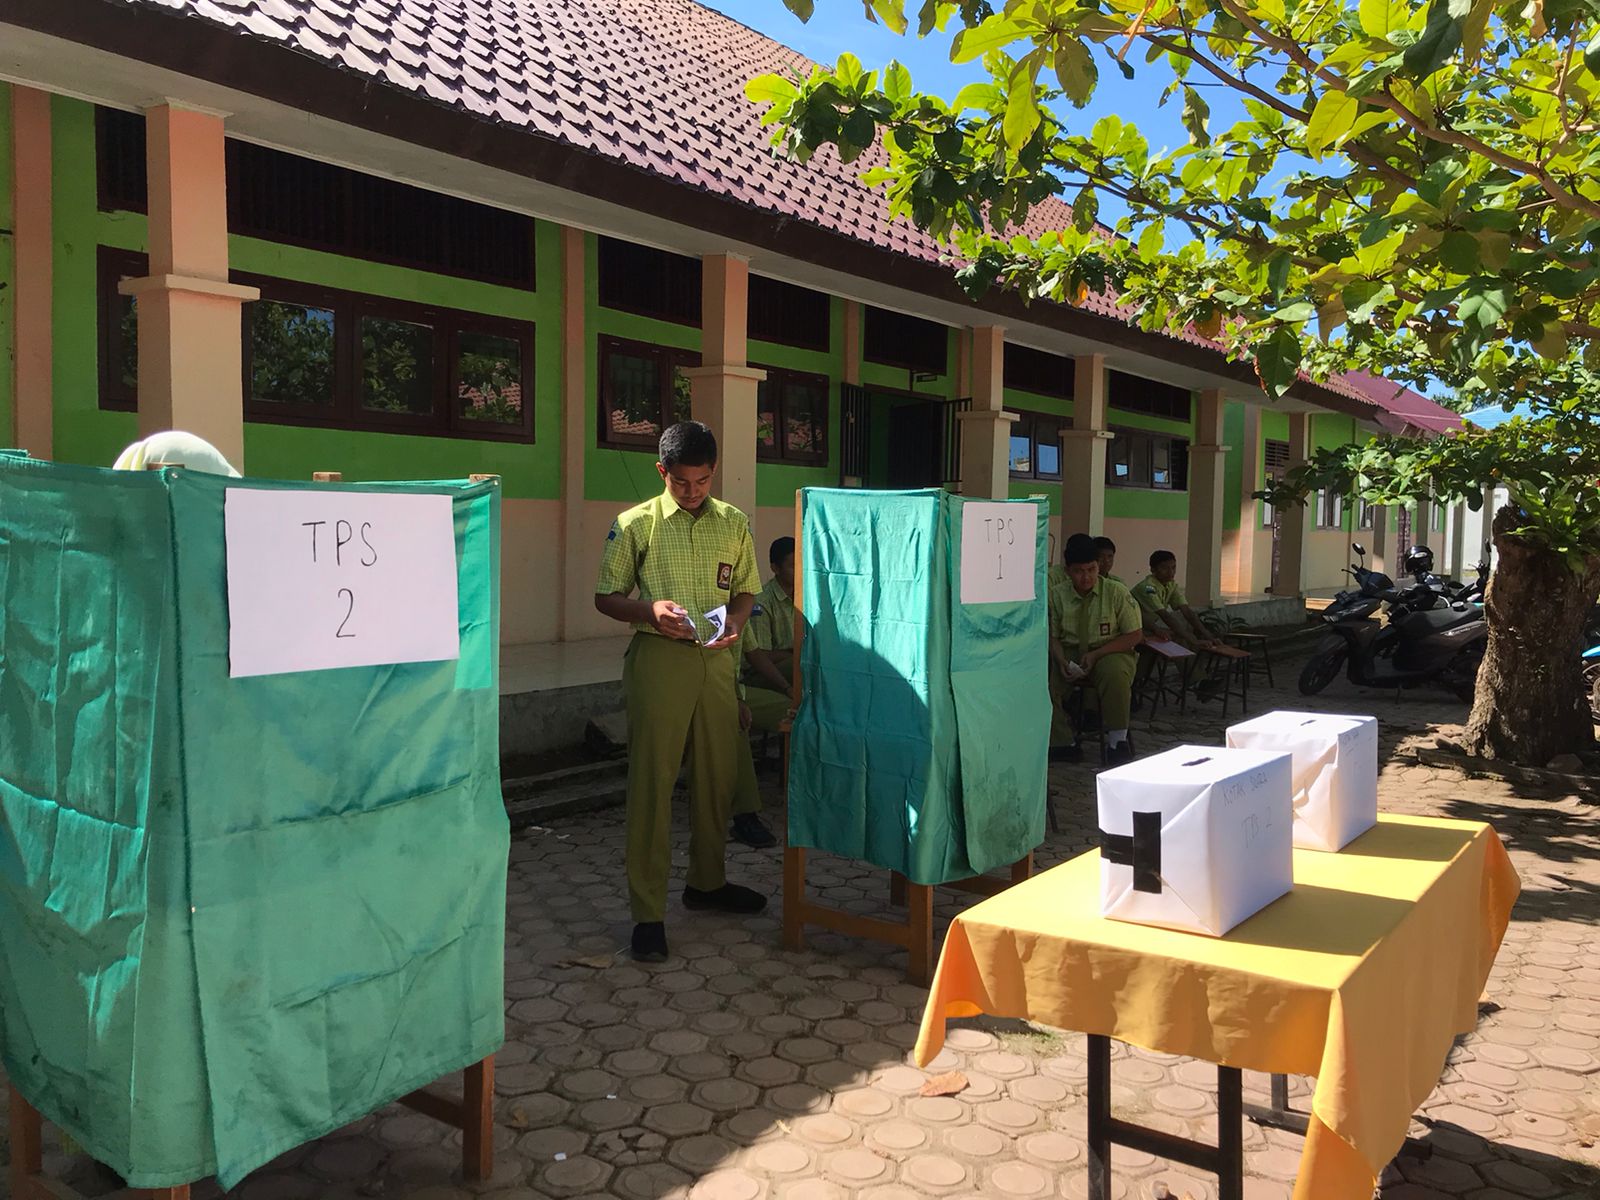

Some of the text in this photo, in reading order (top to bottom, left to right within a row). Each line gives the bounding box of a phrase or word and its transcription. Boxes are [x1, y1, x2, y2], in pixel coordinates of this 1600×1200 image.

[302, 519, 378, 567] TPS
[984, 517, 1015, 546] TPS
[996, 554, 1004, 580] 1
[335, 588, 356, 638] 2
